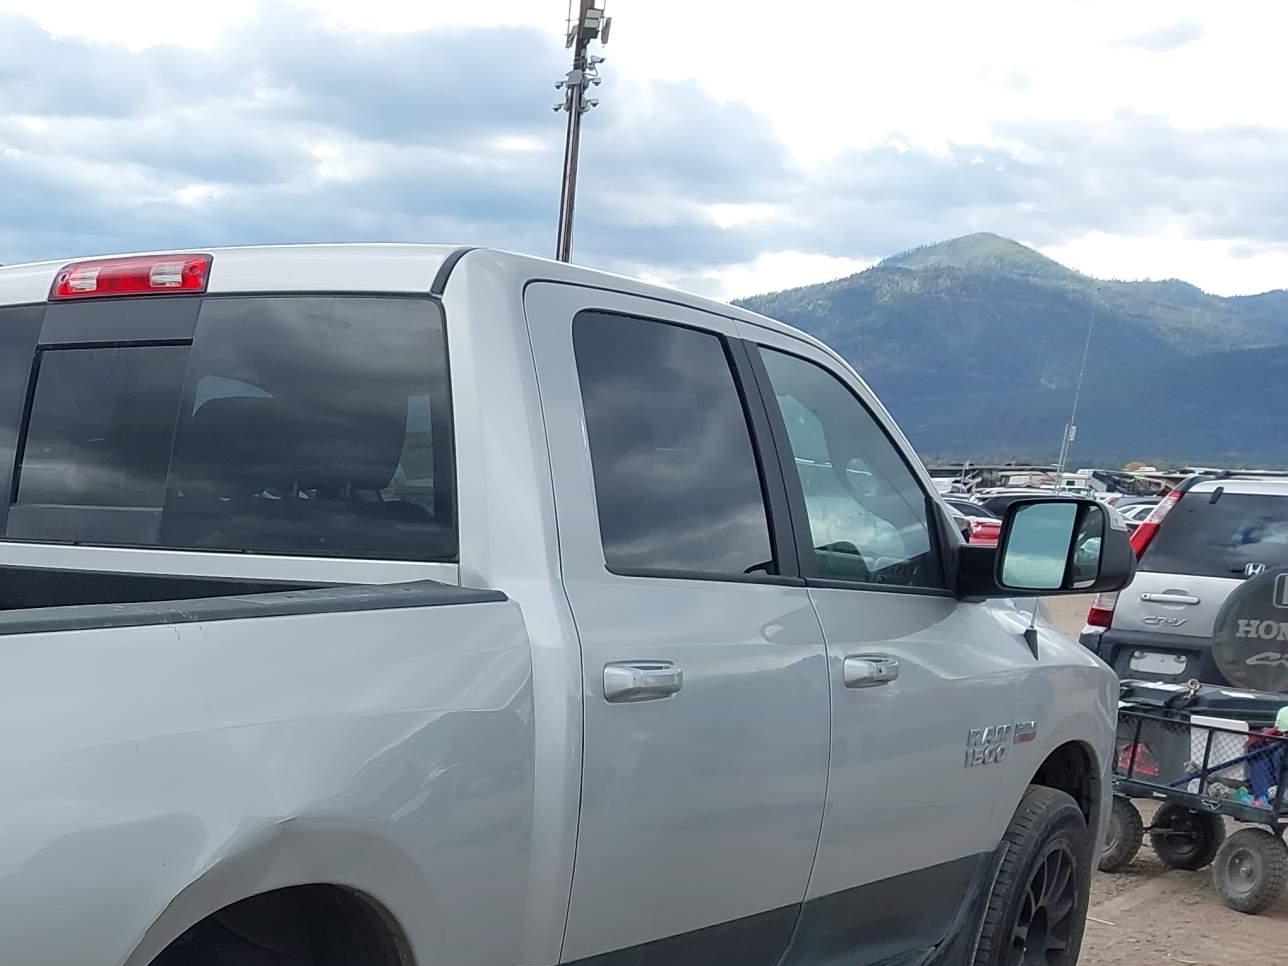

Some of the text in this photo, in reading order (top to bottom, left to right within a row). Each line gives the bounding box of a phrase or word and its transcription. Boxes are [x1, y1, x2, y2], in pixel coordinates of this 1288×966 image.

[1142, 615, 1189, 627] CR-V
[966, 724, 1013, 747] RAM
[964, 744, 1006, 768] 1500
